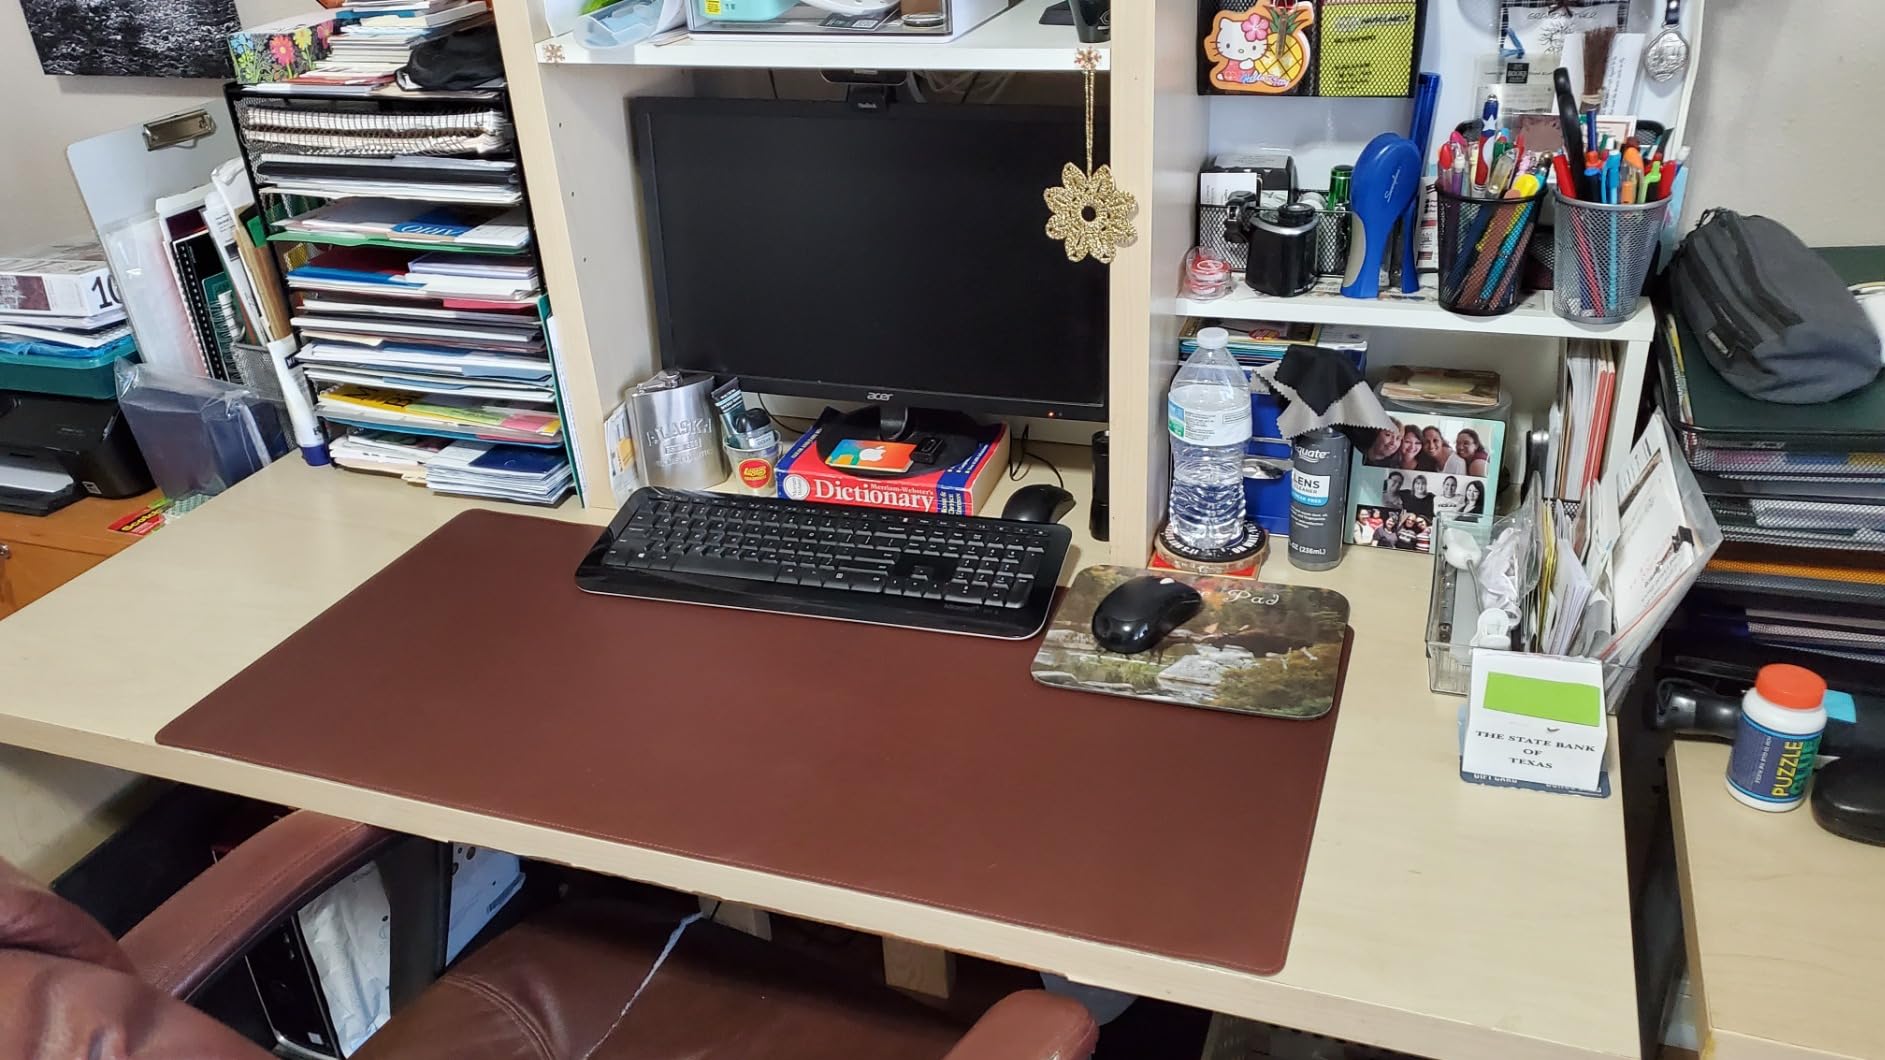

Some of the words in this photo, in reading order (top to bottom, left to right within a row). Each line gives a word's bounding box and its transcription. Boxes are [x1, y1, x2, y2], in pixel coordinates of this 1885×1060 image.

[867, 391, 893, 401] acer
[1293, 474, 1320, 489] LENS
[815, 479, 935, 512] Dictionary
[1224, 589, 1280, 606] Pad
[1475, 730, 1505, 741] THE
[1507, 734, 1552, 747] STATE
[1556, 741, 1596, 752] BANK
[1523, 748, 1543, 756] OF
[1509, 756, 1553, 769] TEXAS
[1771, 741, 1804, 796] PUZZLE
